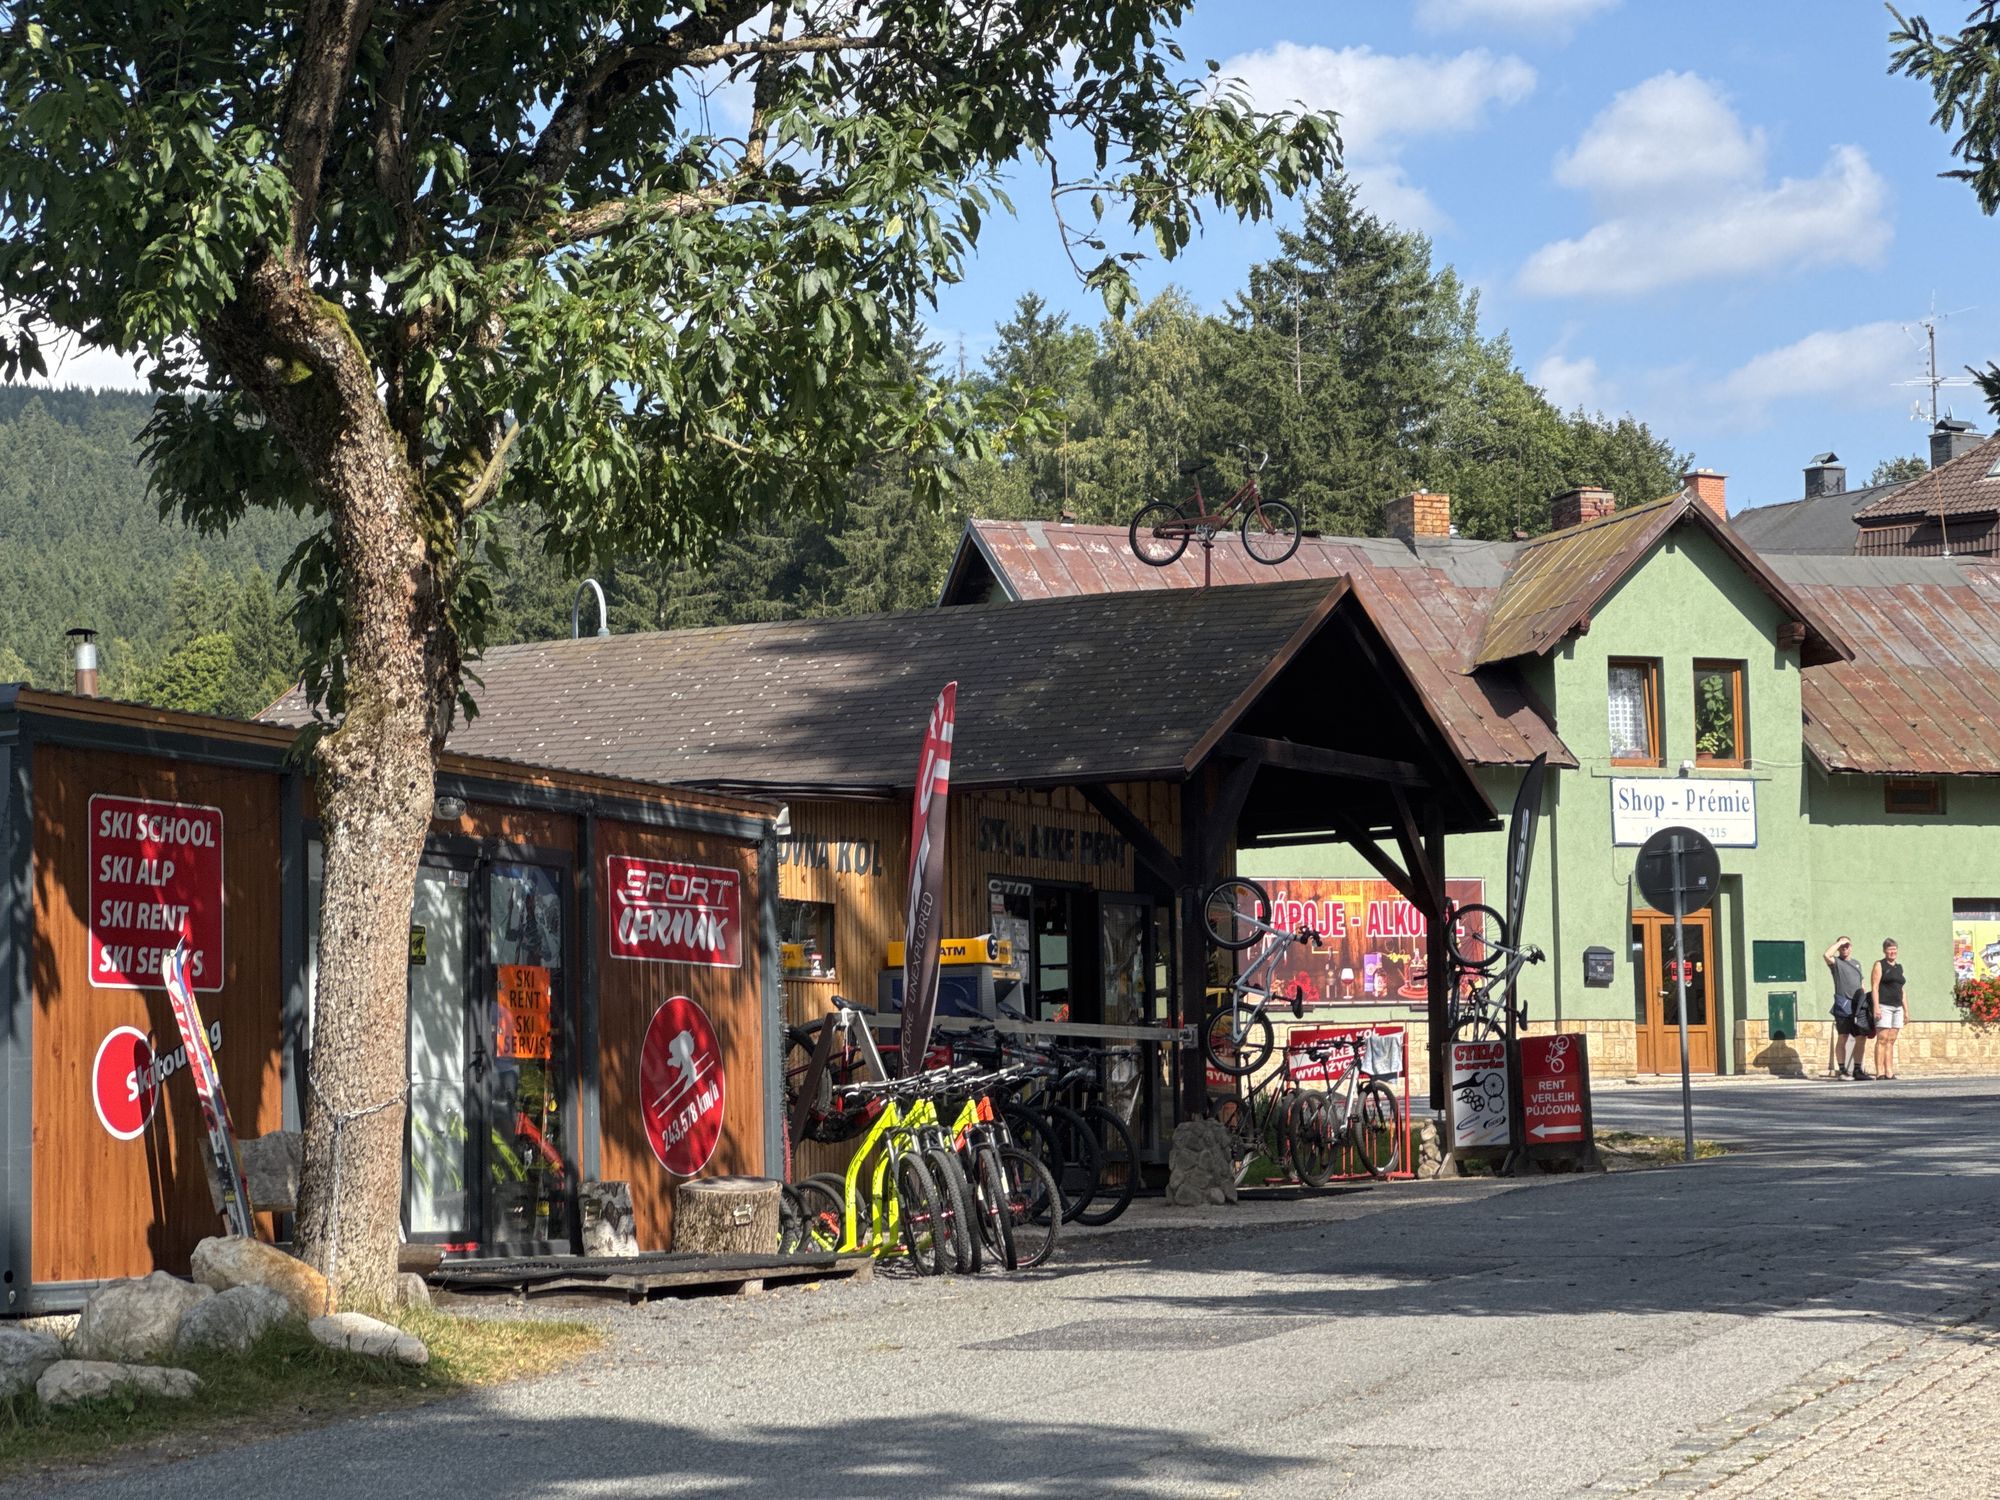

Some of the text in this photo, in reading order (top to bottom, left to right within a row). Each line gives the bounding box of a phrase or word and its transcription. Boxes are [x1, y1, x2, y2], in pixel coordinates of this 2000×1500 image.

[1618, 787, 1665, 817] Shop
[1686, 788, 1751, 813] Prémie
[99, 810, 215, 848] SKI SCHOOL
[99, 855, 175, 887] SKI ALP
[836, 836, 882, 877] KOL
[624, 868, 733, 905] SPORT
[99, 900, 189, 932] SKI RENT
[99, 945, 204, 977] SKI SES
[910, 891, 934, 1004] UNEXPLORED
[516, 970, 535, 988] SKI
[509, 990, 541, 1009] RENT
[516, 1015, 535, 1034] SKI
[126, 1019, 222, 1102] Skitoug
[503, 1036, 546, 1055] SERVIS
[1455, 1043, 1505, 1061] CYKLO
[1531, 1092, 1575, 1104] VERLEIH
[1538, 1080, 1566, 1090] RENT
[662, 1079, 720, 1153] 243,578 km/h
[1526, 1104, 1582, 1117] PŮJČOVNA
